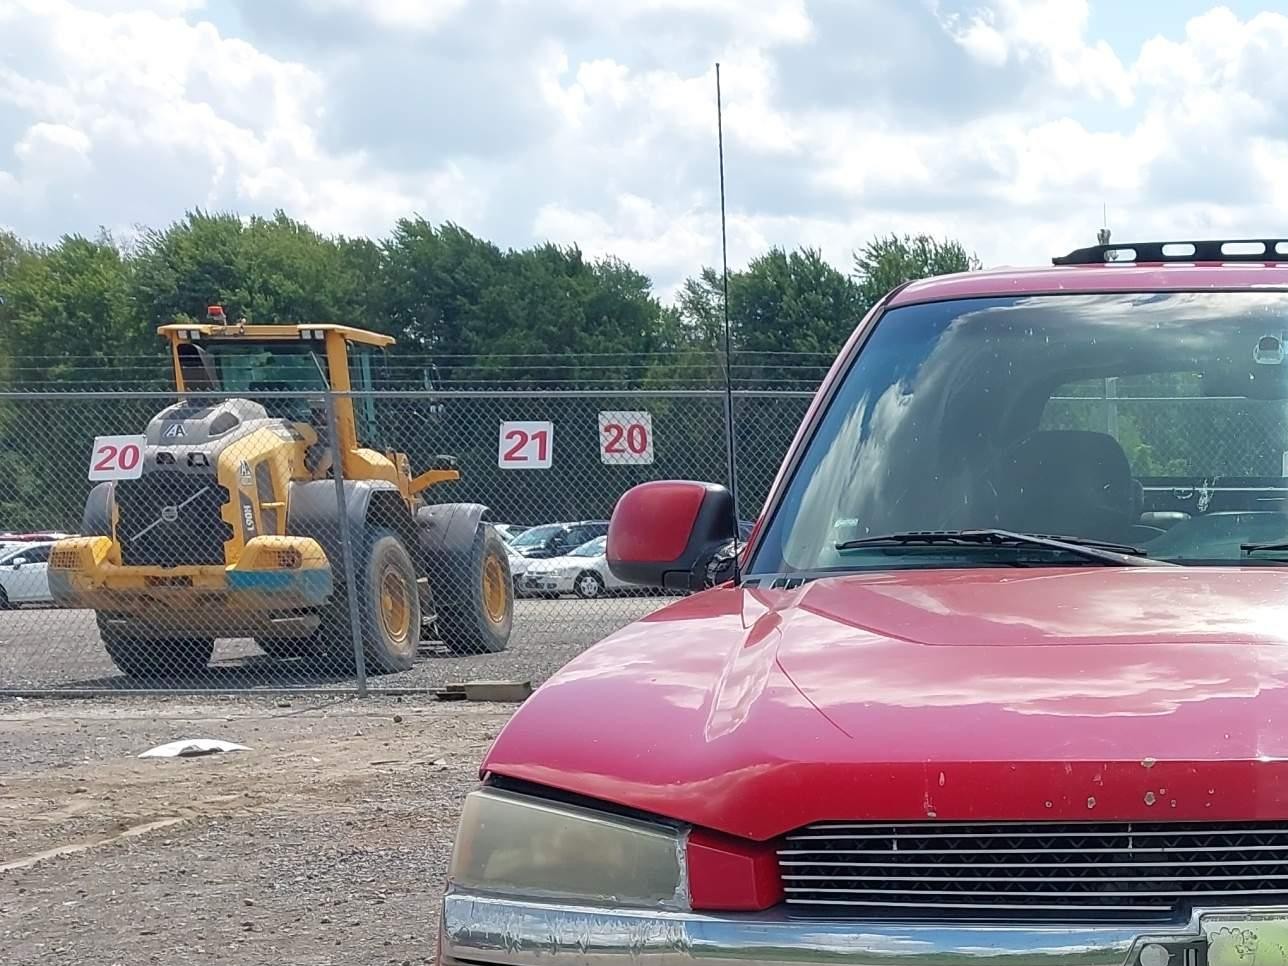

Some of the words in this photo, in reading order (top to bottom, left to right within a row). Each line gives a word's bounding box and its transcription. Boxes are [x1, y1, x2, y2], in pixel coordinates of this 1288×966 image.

[503, 430, 548, 461] 21
[604, 424, 648, 454] 20
[93, 444, 140, 471] 20
[243, 504, 255, 531] L90H
